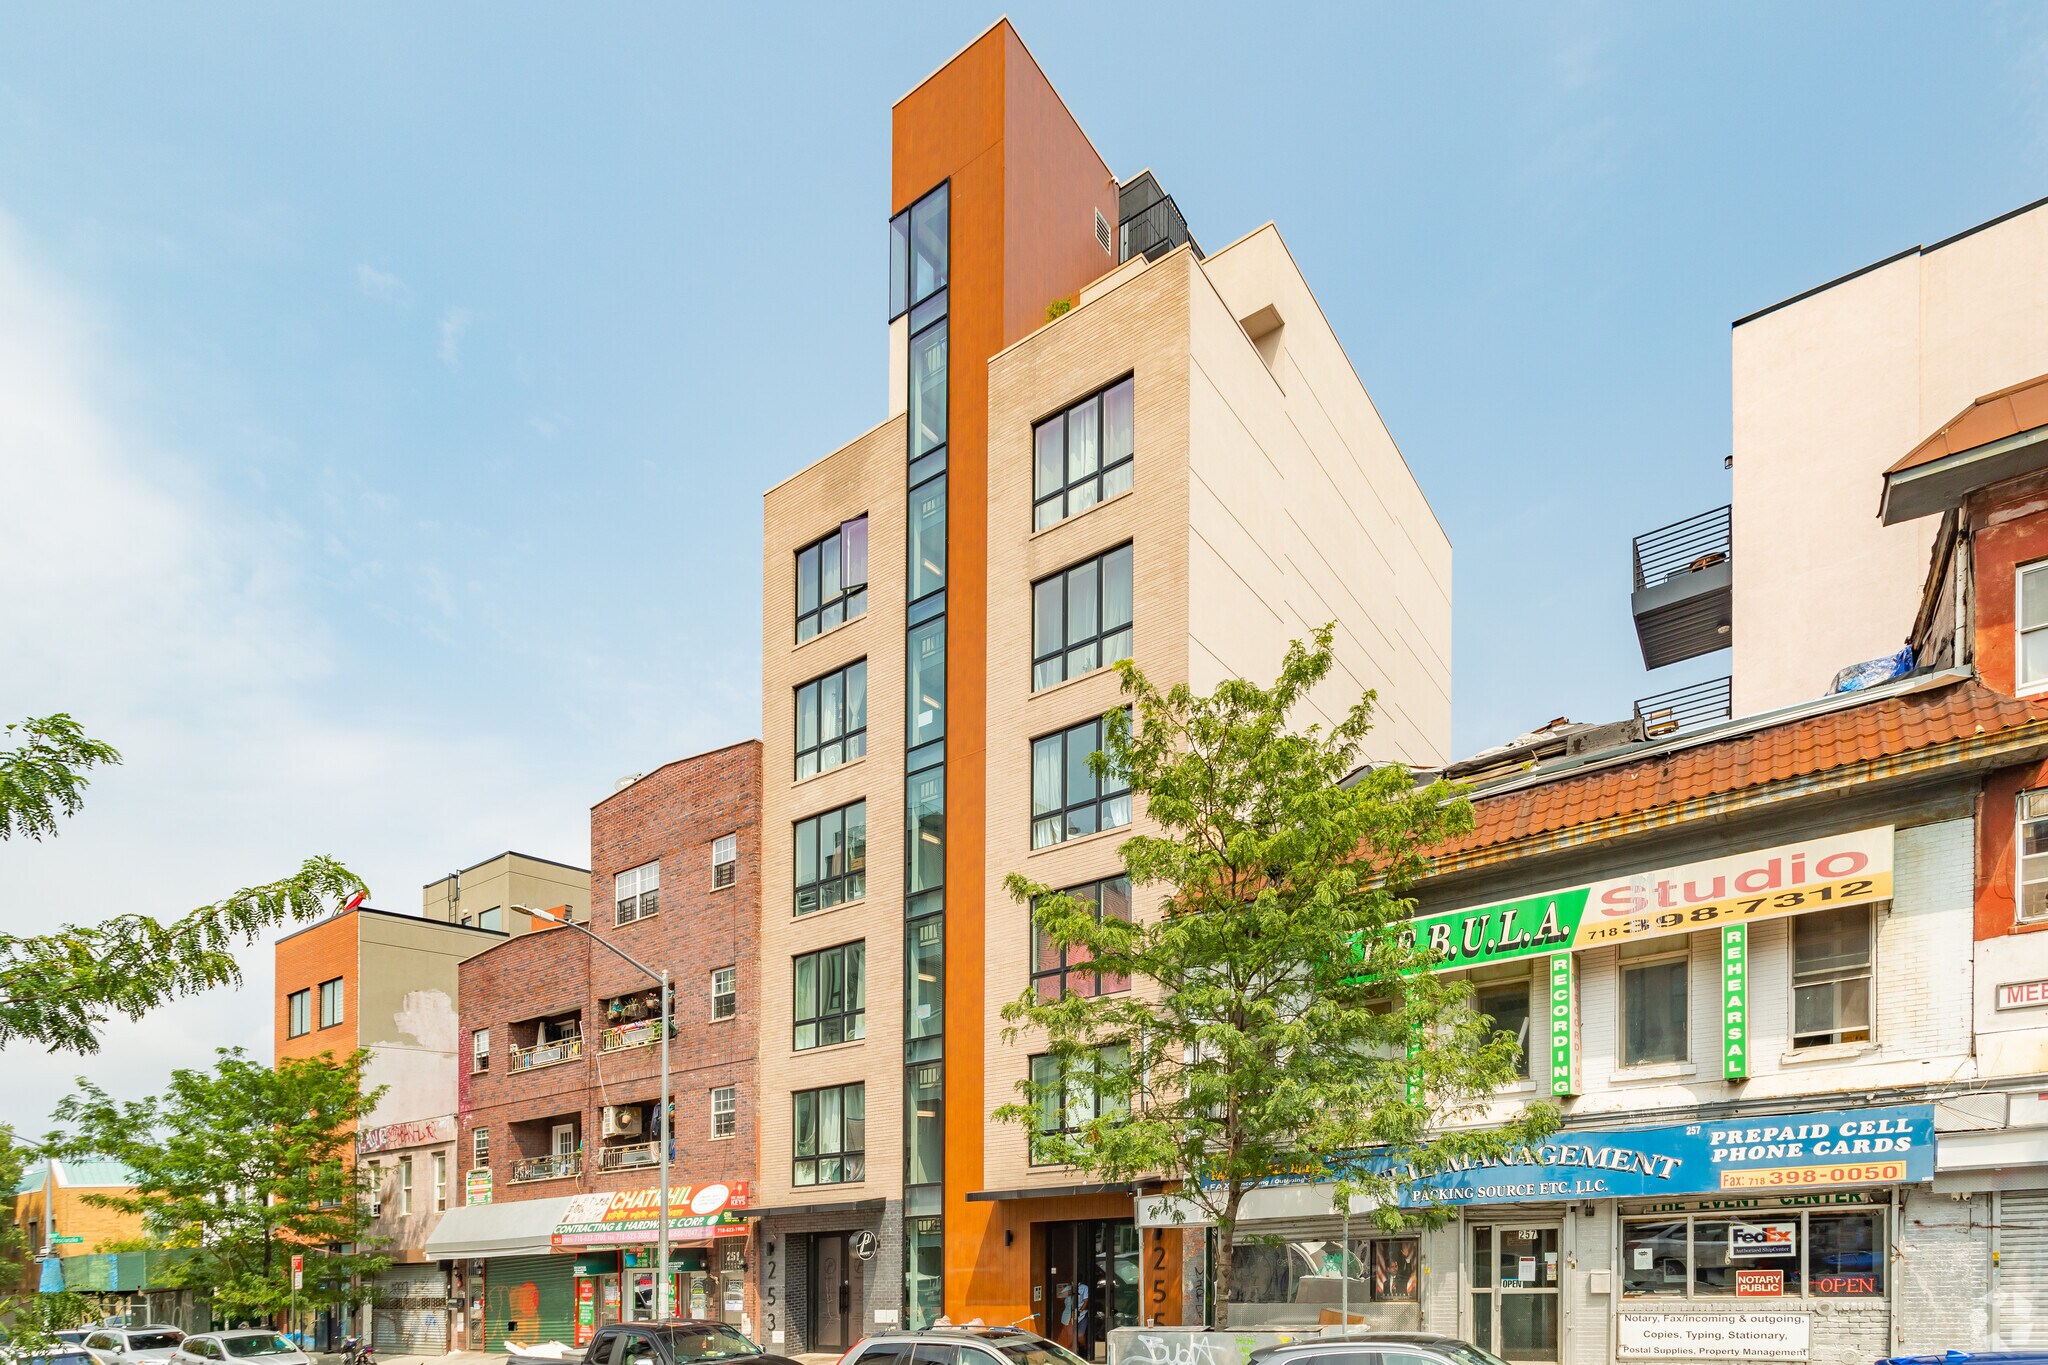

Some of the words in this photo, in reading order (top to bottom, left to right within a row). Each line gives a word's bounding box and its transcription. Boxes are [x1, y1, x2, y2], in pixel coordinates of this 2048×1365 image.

[1601, 850, 1869, 916] Studio
[1588, 926, 1618, 941] 718
[1622, 880, 1873, 934] 398-7312
[1727, 931, 1743, 1072] REHEARSAL
[1553, 959, 1568, 1093] RECORDING
[1686, 1125, 1701, 1136] 257
[1710, 1123, 1829, 1146] PREPAID
[1839, 1118, 1914, 1137] CELL
[1711, 1142, 1804, 1163] PHONE
[1812, 1136, 1912, 1156] CARDS
[1444, 1144, 1683, 1180] MANAGEMENT
[1723, 1173, 1745, 1187] Fax:
[1748, 1177, 1766, 1186] 718
[1769, 1166, 1898, 1185] 398-0050
[1412, 1183, 1474, 1202] PACKING
[1477, 1183, 1536, 1198] SOURCE
[1539, 1181, 1572, 1195] ETC.
[1576, 1179, 1609, 1194] LLC.
[554, 1222, 615, 1234] CONTRACTING
[615, 1222, 622, 1230] &
[623, 1218, 676, 1231] HARDWE
[677, 1217, 703, 1228] CORP.
[1519, 1230, 1536, 1239] 257
[1733, 1227, 1792, 1244] FedEx
[727, 1251, 739, 1261] 251
[1502, 1280, 1522, 1288] OPEN
[1738, 1275, 1781, 1284] NOTARY
[1740, 1284, 1779, 1292] PUBLIC
[1820, 1277, 1875, 1294] OPEN
[767, 1261, 776, 1331] 253
[1624, 1314, 1660, 1324] Notary,
[1663, 1314, 1735, 1325] Fax/incoming
[1739, 1314, 1747, 1323] &
[1750, 1314, 1805, 1325] outgoing,
[1643, 1330, 1682, 1340] Copies,
[1686, 1330, 1725, 1341] Typing,
[1728, 1331, 1788, 1341] Stationary,
[1623, 1346, 1651, 1354] Postal
[1653, 1346, 1696, 1355] Supplies,
[1699, 1347, 1740, 1356] Property
[1742, 1348, 1807, 1357] Management
